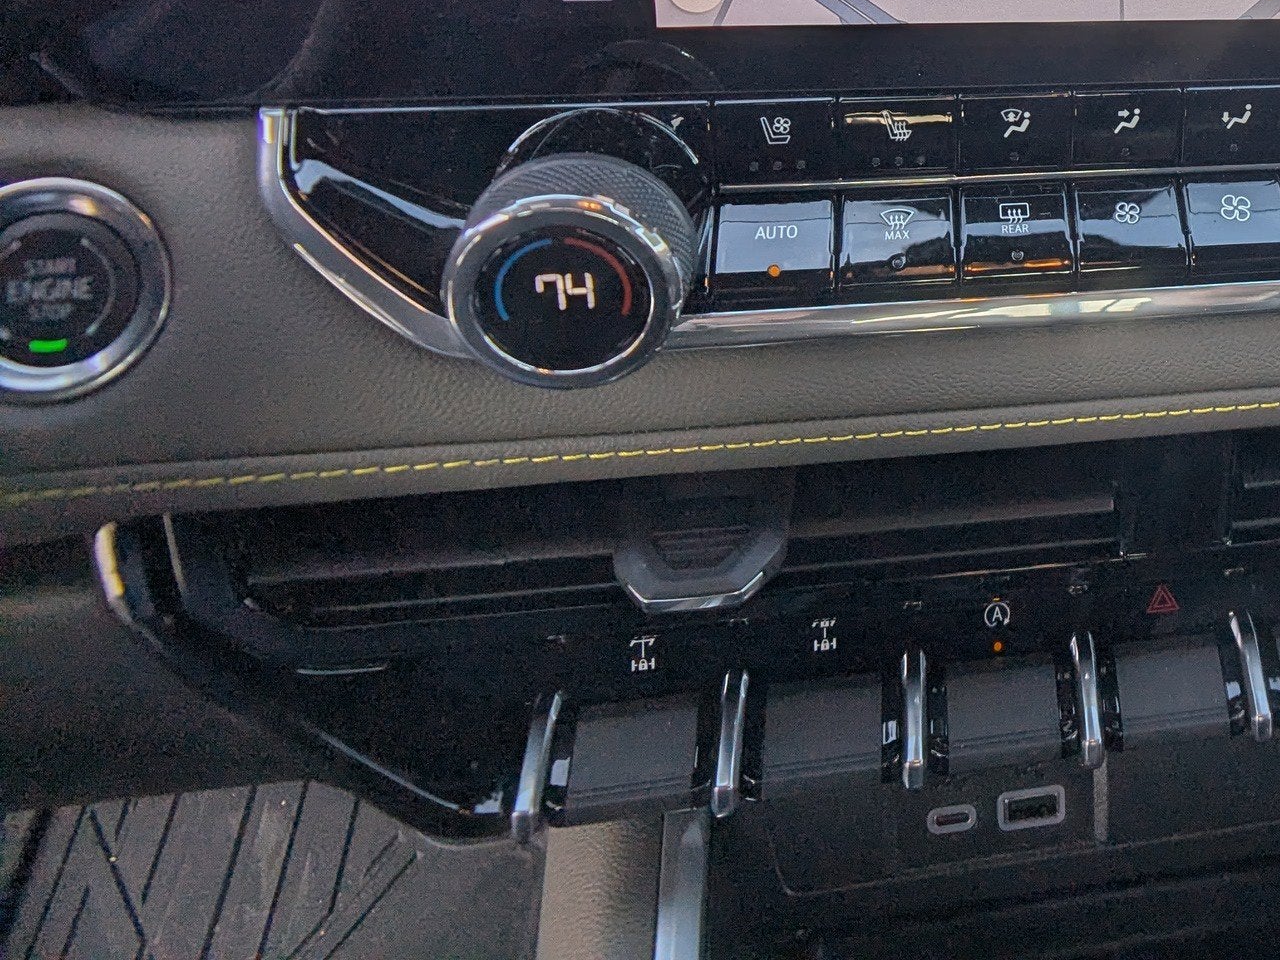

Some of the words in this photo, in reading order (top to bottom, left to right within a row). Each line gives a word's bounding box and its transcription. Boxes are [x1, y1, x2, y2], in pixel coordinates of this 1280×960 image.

[755, 225, 799, 240] AUTO
[884, 229, 911, 241] MAX
[1001, 223, 1030, 234] REAR
[534, 272, 596, 311] 74
